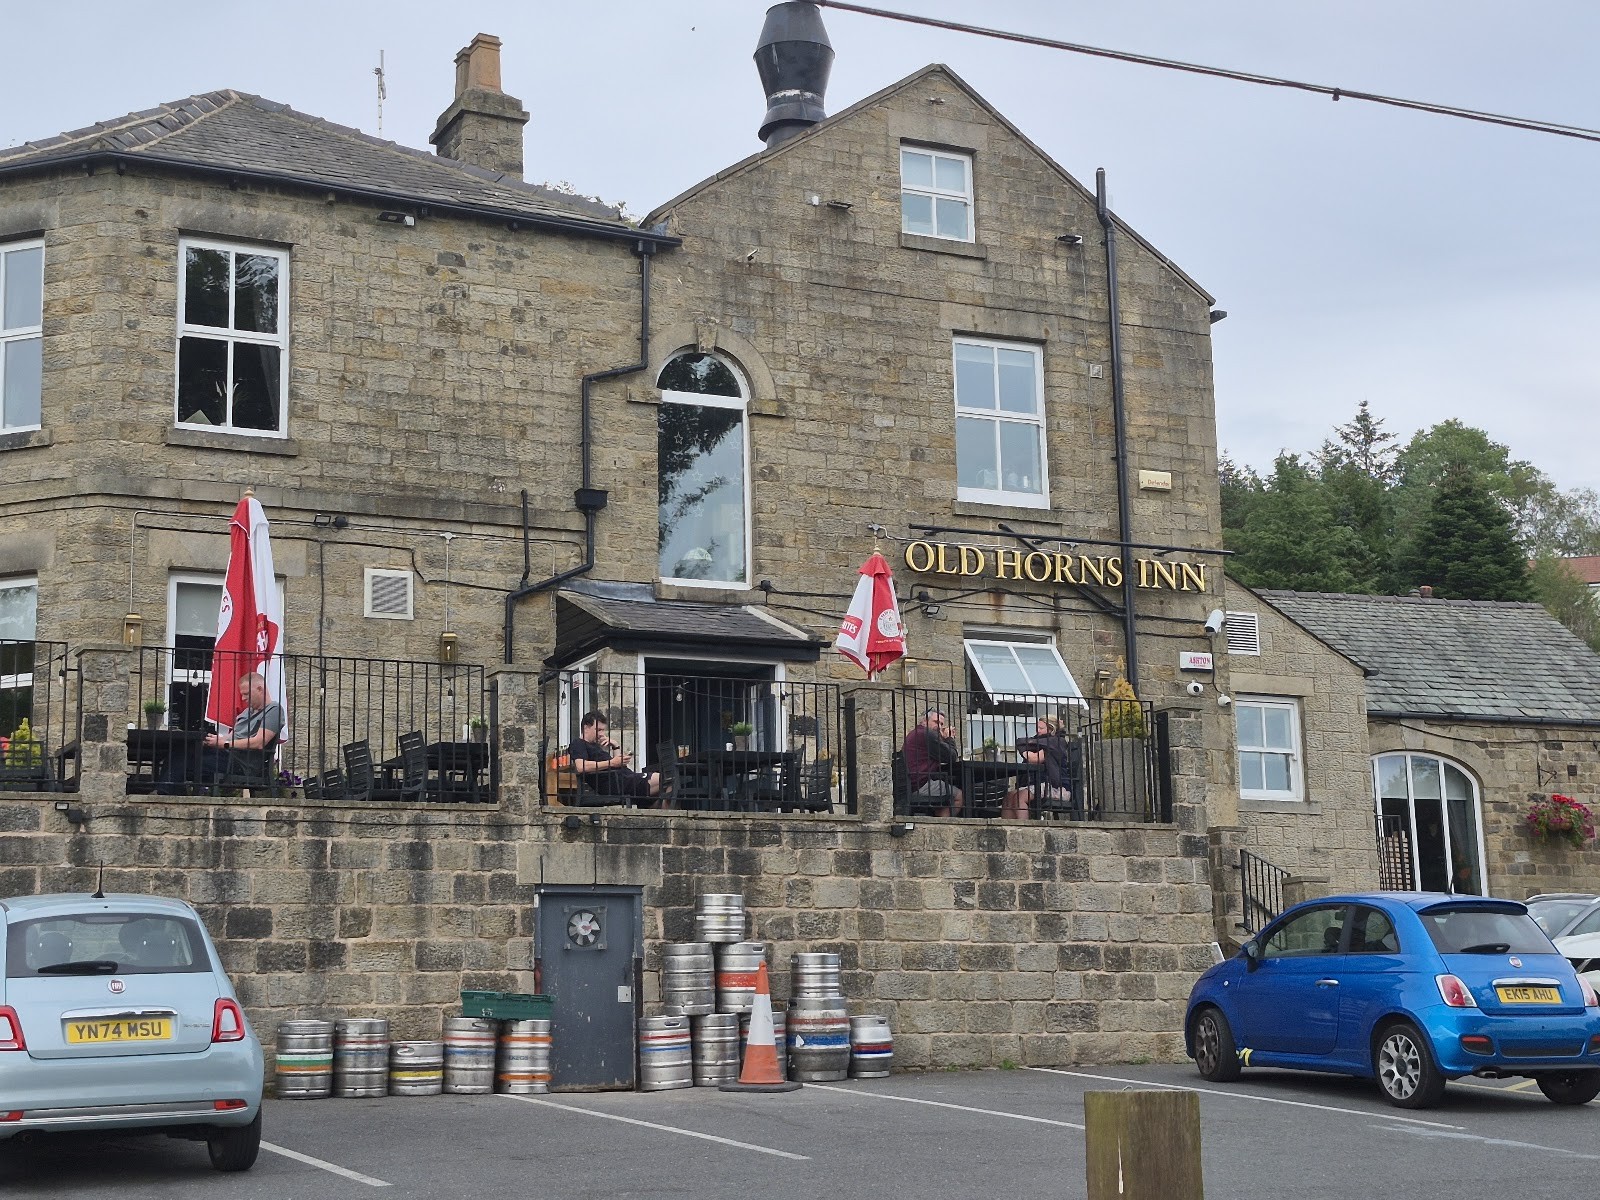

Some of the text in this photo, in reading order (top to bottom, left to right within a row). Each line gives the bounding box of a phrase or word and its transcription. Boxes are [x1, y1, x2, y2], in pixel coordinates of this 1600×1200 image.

[905, 541, 1206, 592] OLD HORNS INN
[1505, 988, 1553, 1001] EK15 AHU
[75, 1021, 162, 1040] YN74 MSU
